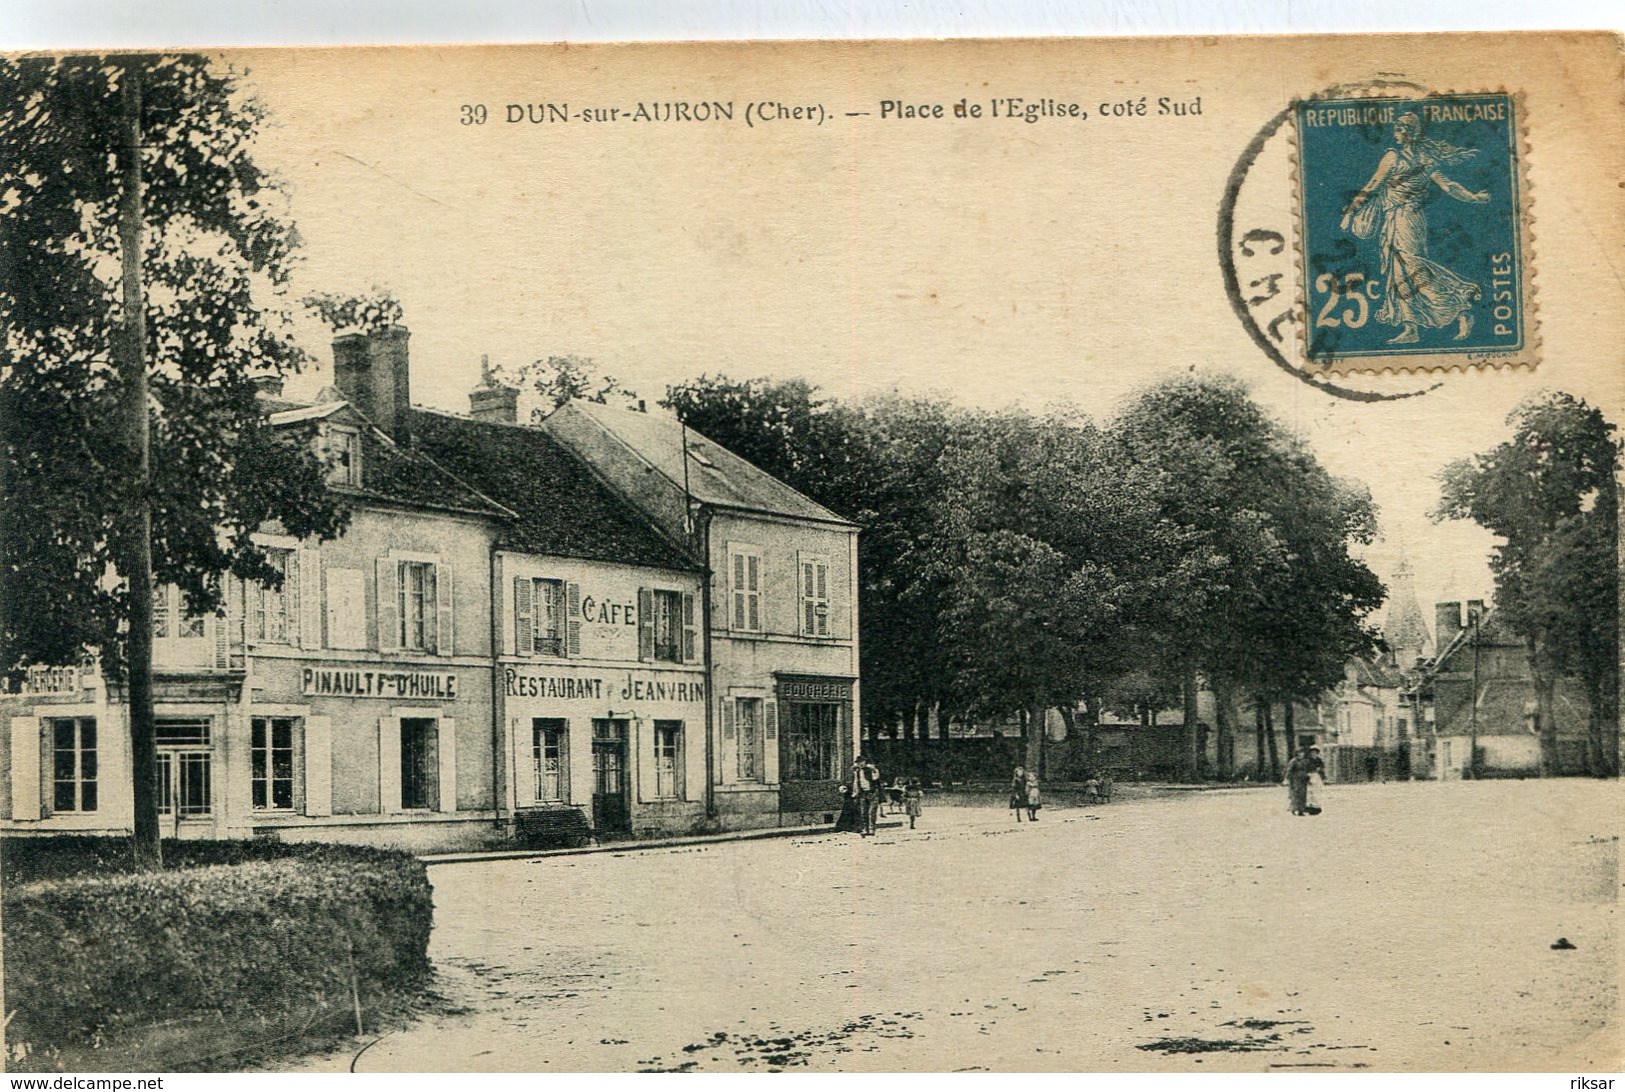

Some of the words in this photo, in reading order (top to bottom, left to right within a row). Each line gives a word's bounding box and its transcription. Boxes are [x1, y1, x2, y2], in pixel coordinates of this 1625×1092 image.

[1421, 103, 1507, 123] FRANÇAISE
[1491, 251, 1513, 338] POSTES
[302, 667, 374, 695] PINAULT
[504, 667, 603, 700] RESTAURANT
[621, 672, 705, 703] JEANVRIN
